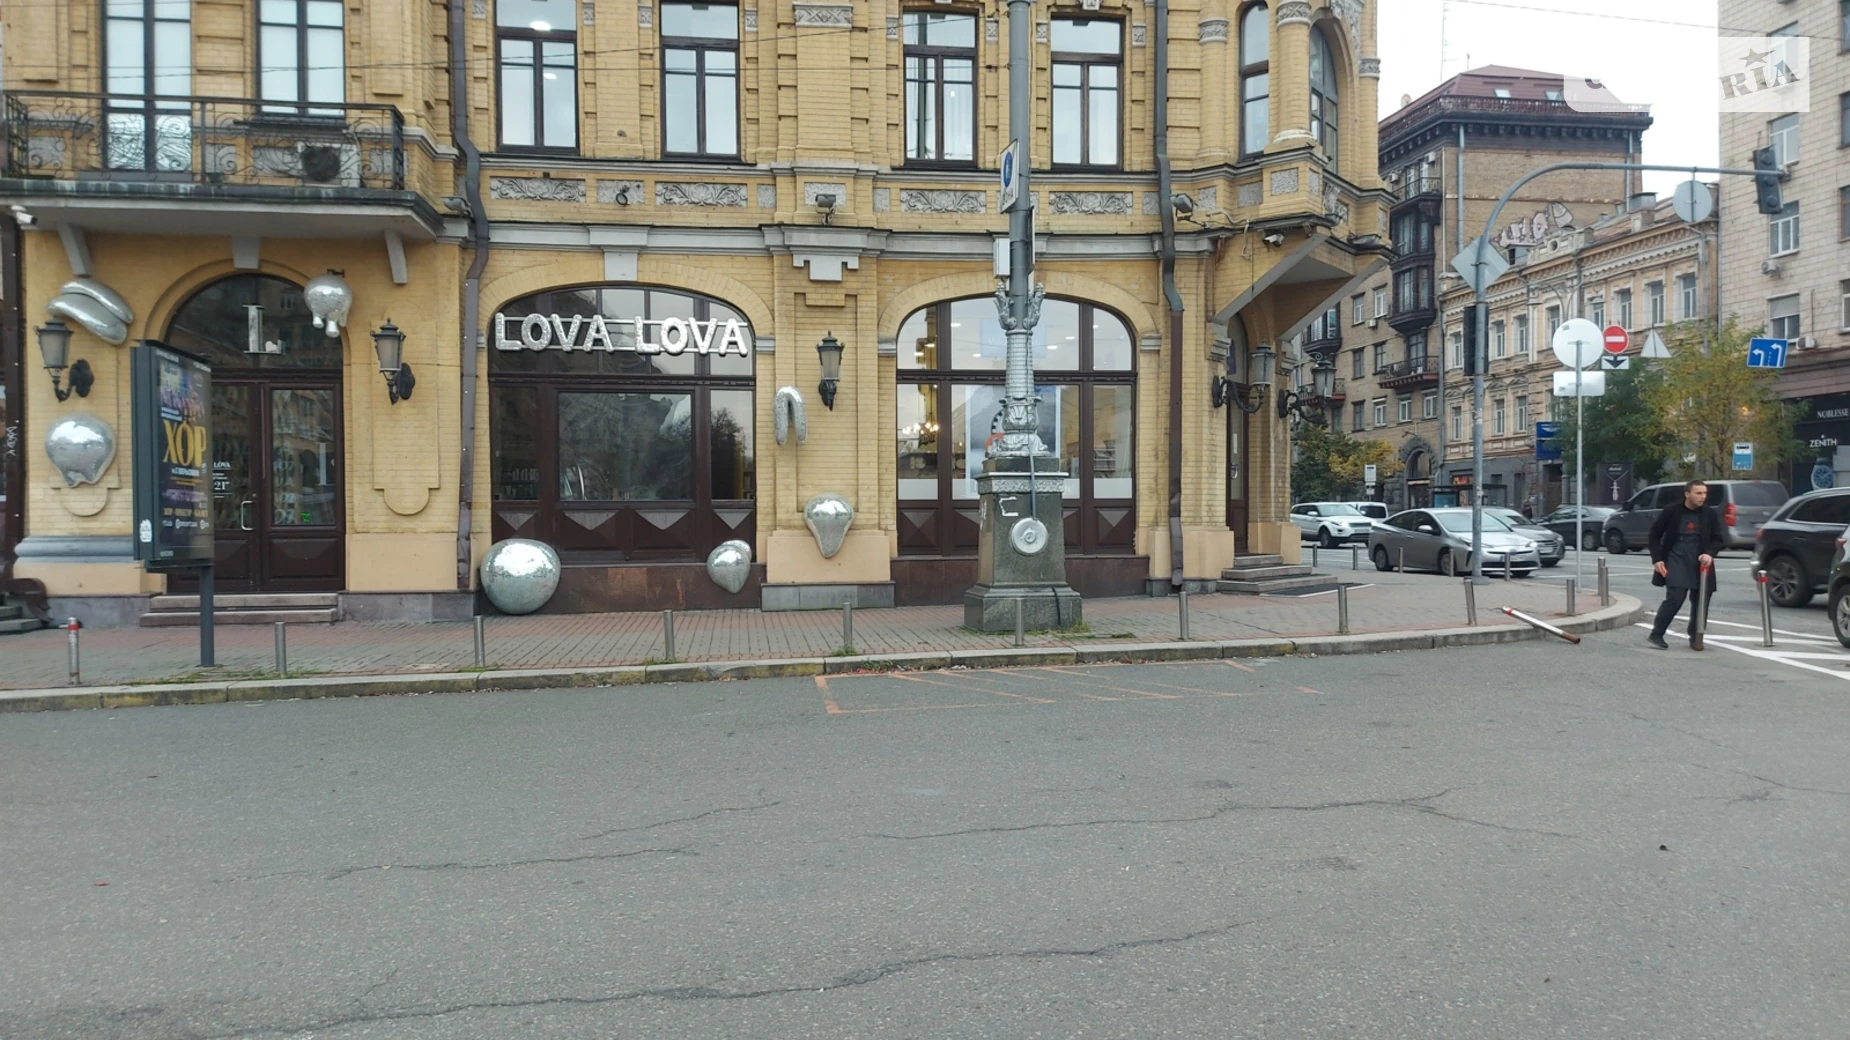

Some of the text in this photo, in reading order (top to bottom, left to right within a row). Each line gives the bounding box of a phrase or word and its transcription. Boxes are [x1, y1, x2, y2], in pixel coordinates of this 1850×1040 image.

[495, 312, 748, 357] LOVA LOVA
[1817, 408, 1849, 418] NOBLESSE
[1809, 438, 1837, 447] ZENITH
